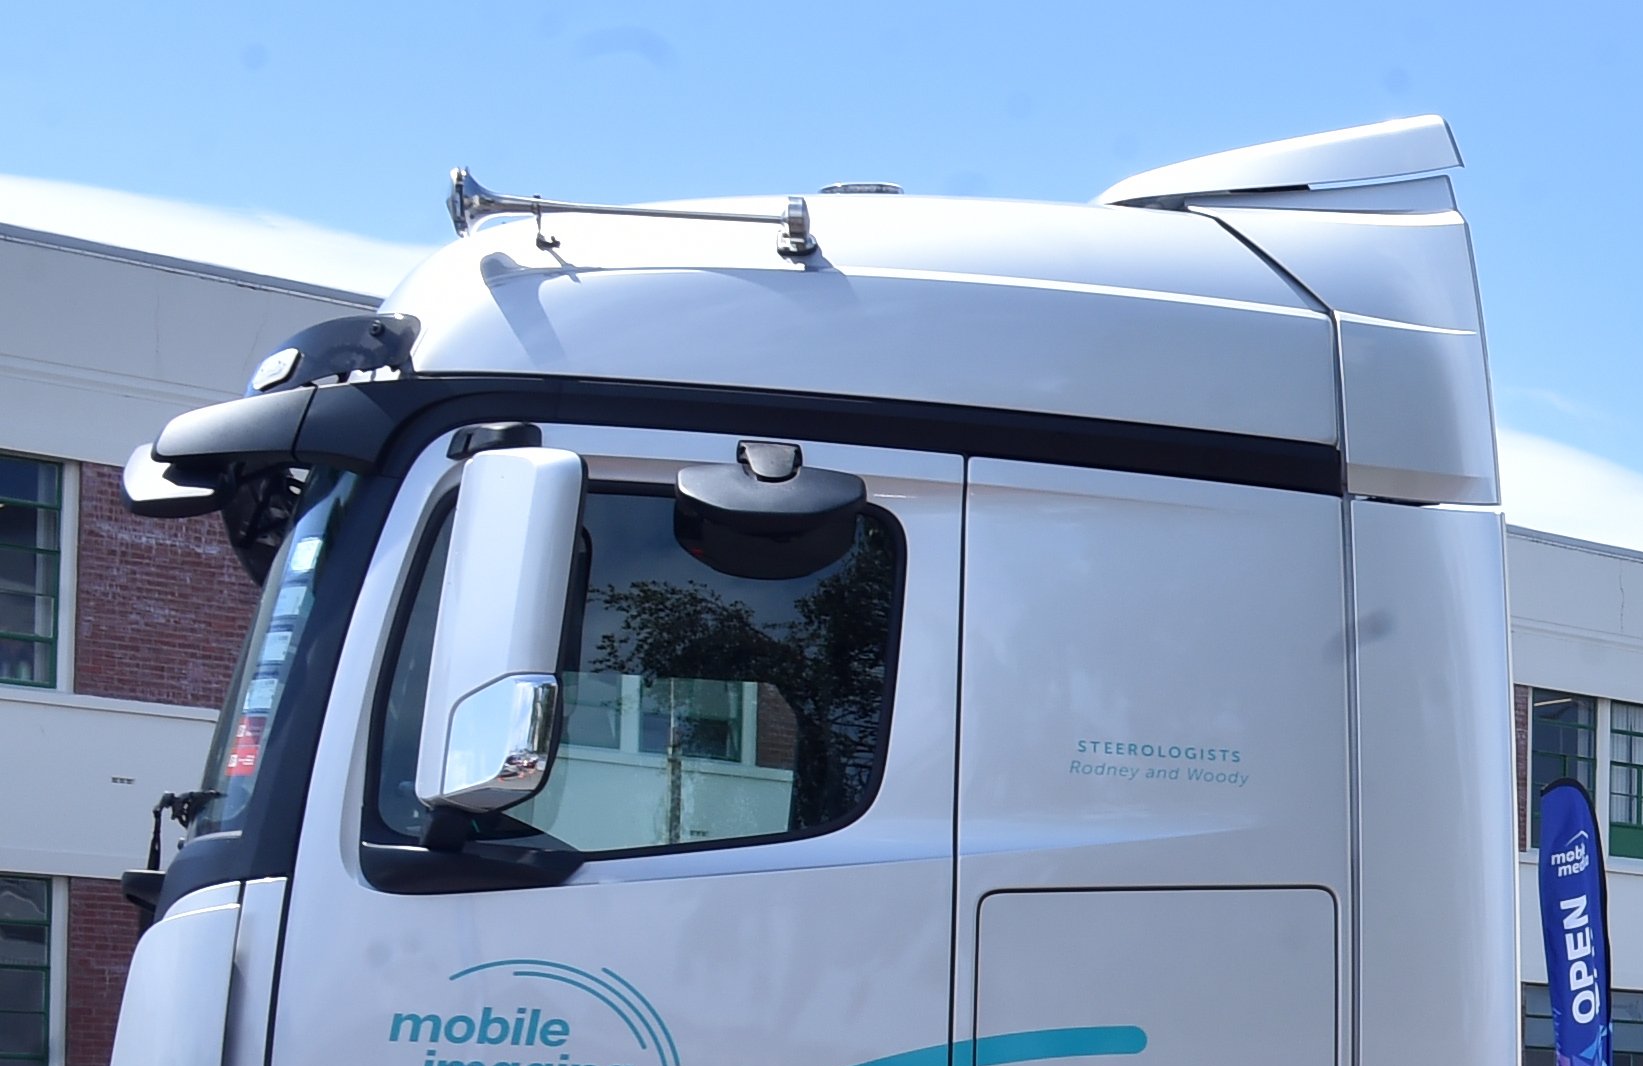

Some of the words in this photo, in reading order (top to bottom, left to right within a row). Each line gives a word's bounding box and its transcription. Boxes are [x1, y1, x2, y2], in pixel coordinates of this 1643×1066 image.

[1077, 739, 1241, 763] STEEROLOGISTS
[1069, 760, 1140, 780] Rodney
[1145, 767, 1180, 780] and
[1187, 768, 1250, 787] Woody
[1560, 895, 1597, 1024] OPEN
[389, 1006, 570, 1047] mobile
